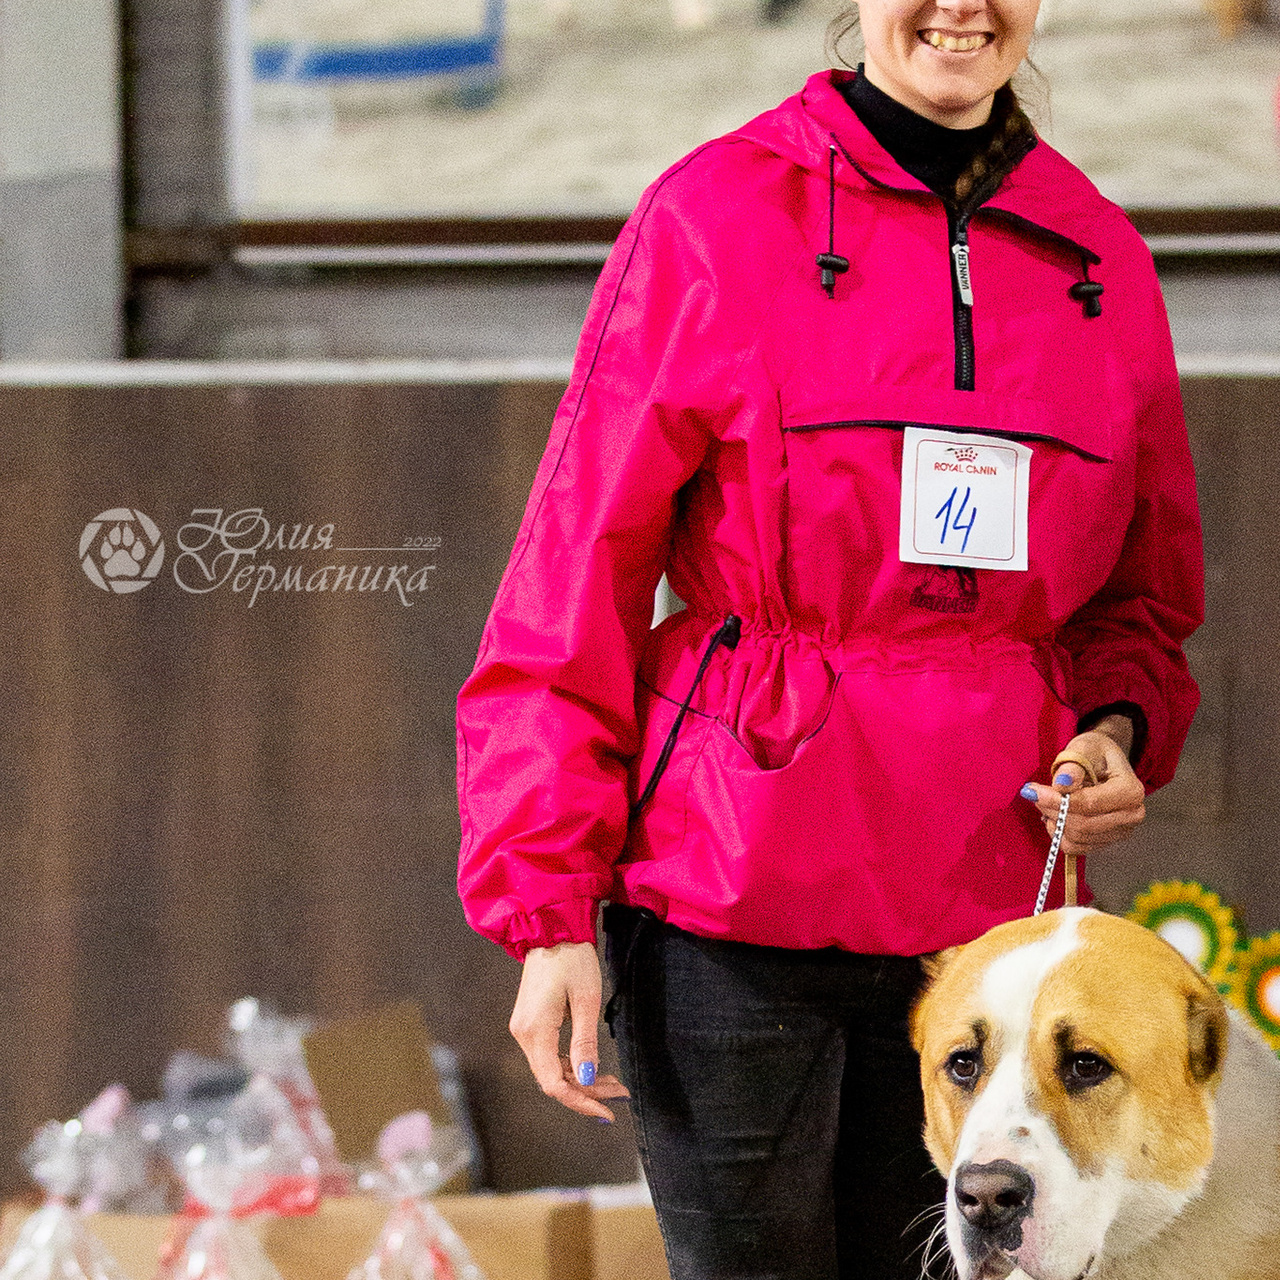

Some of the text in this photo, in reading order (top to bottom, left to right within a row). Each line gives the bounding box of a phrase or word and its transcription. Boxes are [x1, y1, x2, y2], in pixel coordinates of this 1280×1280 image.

[934, 462, 997, 476] ROYAL CANIN
[935, 486, 977, 553] 14
